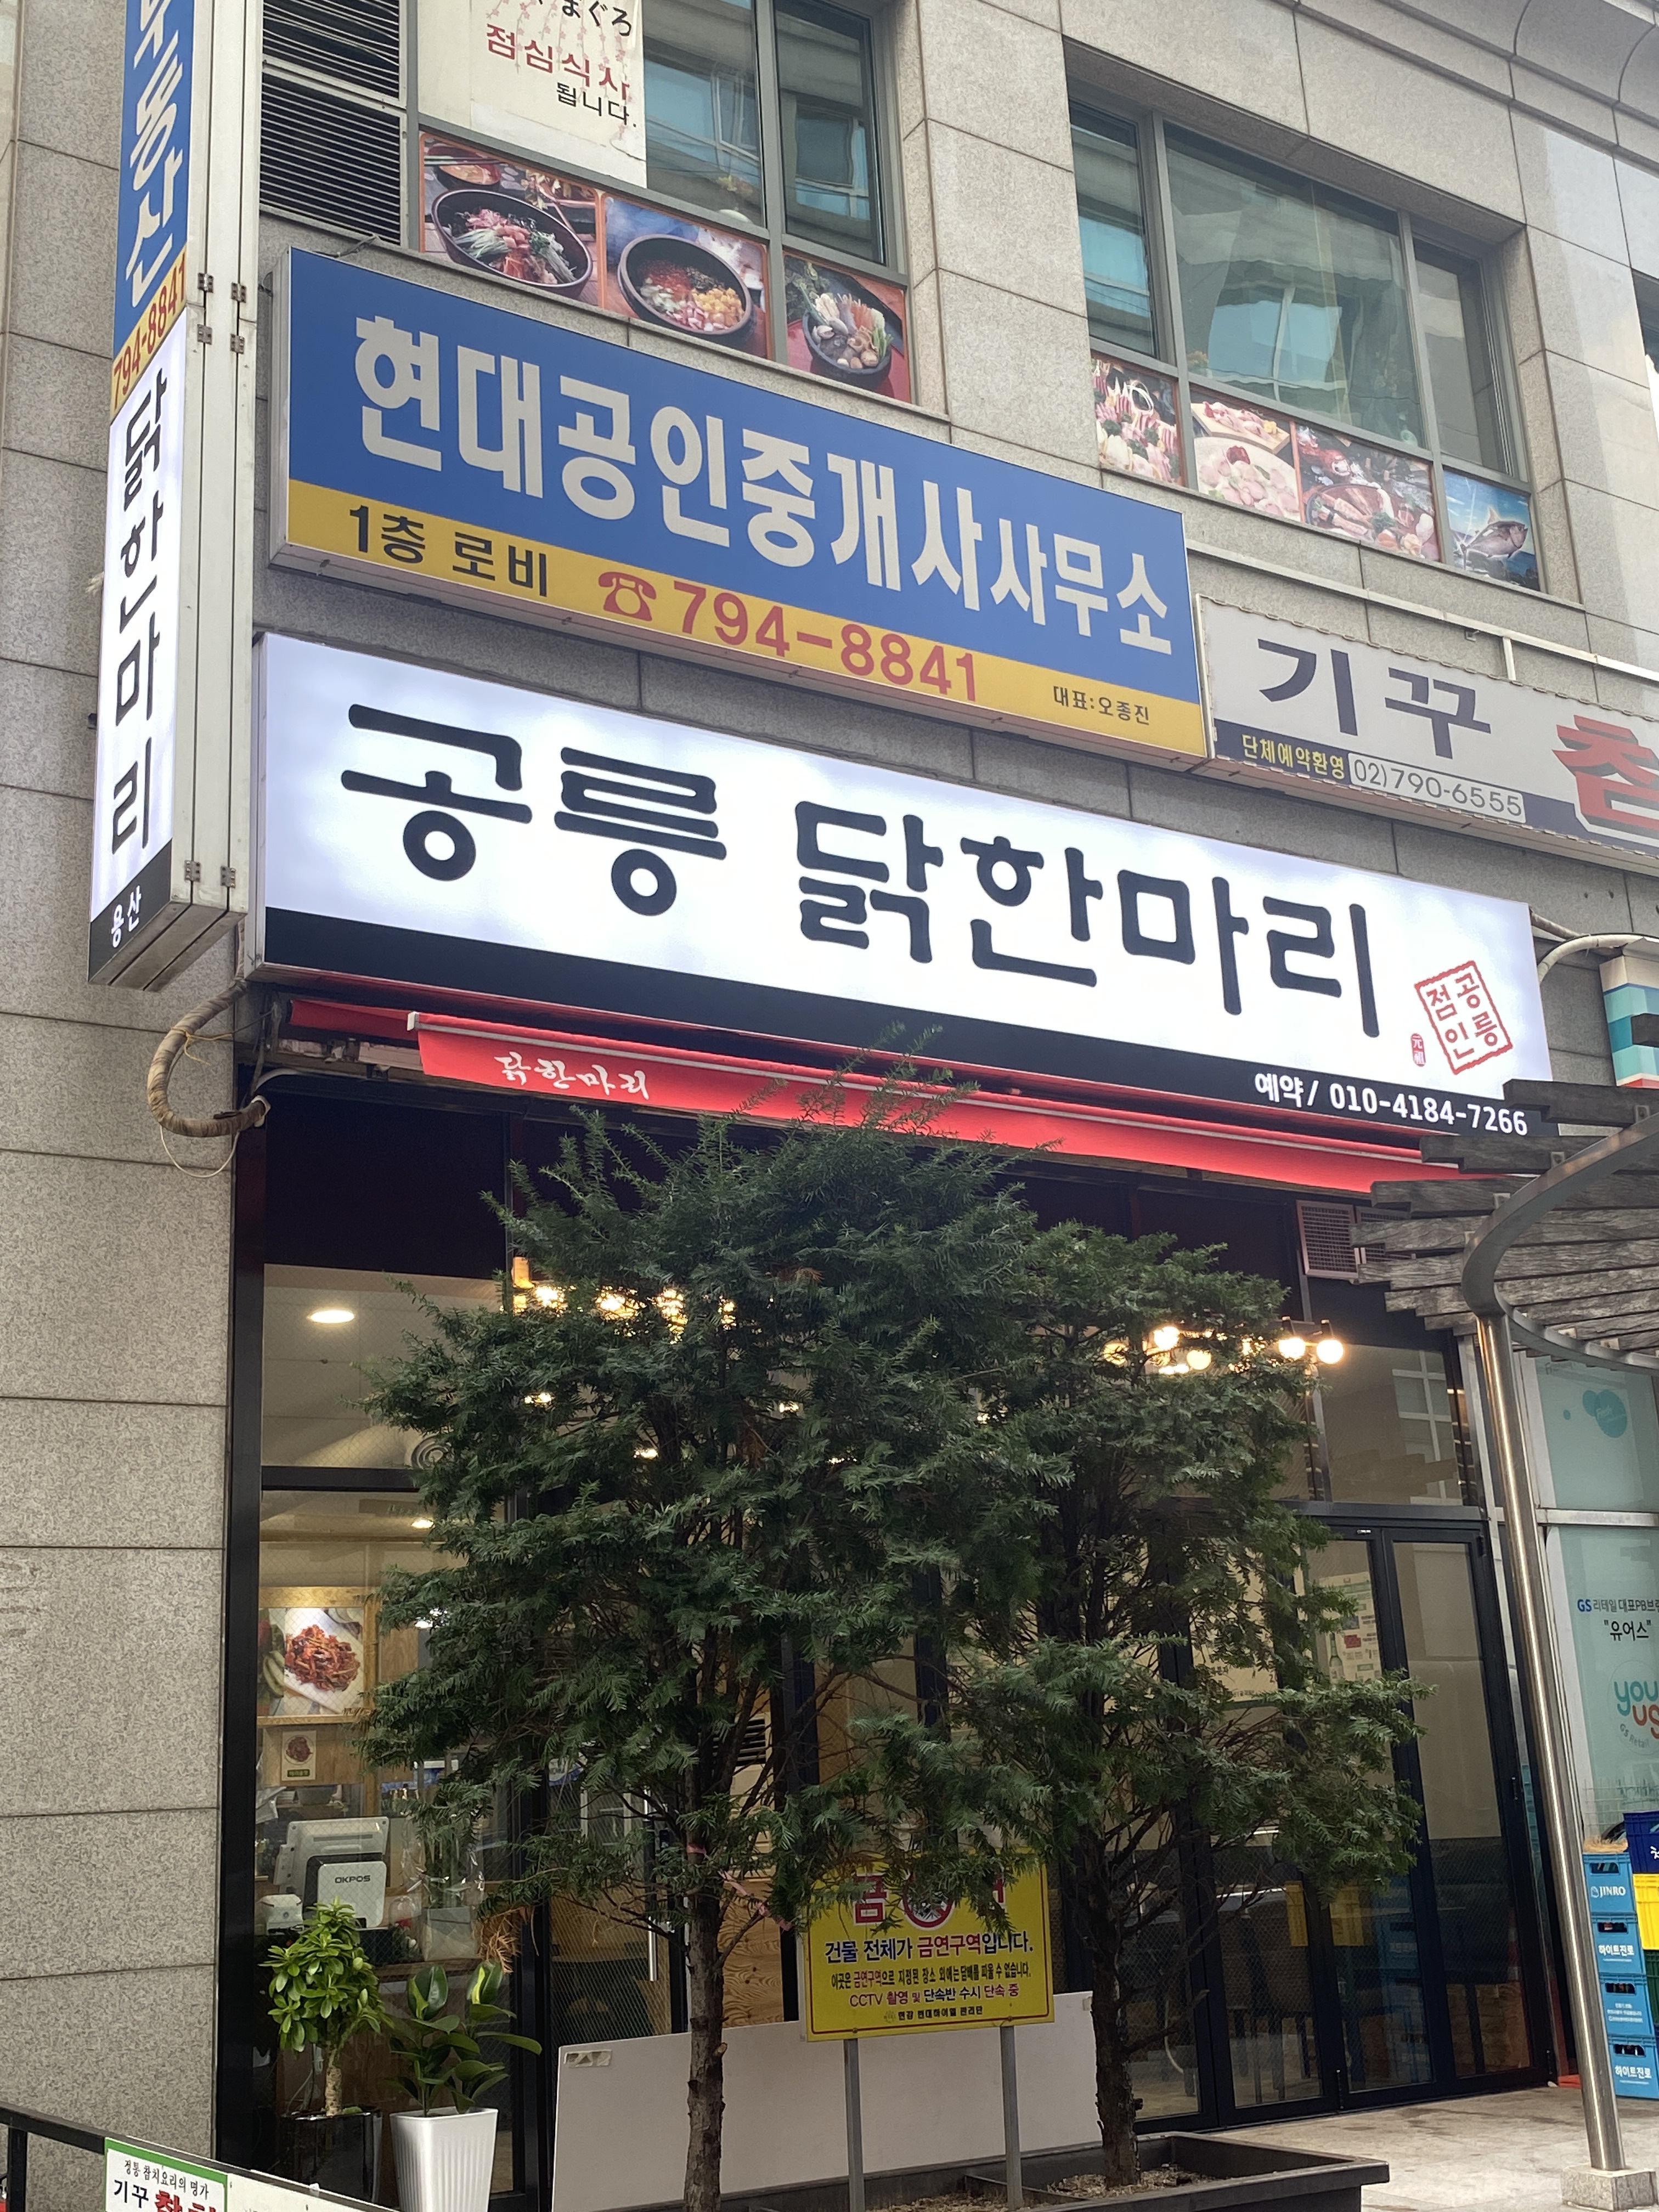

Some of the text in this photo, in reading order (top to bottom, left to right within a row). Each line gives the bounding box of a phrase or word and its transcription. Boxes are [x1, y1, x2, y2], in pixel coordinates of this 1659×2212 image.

[486, 23, 630, 100] 점심식사
[556, 82, 637, 128] 됩니다.
[113, 253, 186, 410] 794-8841
[111, 367, 167, 855] 닭한마리
[349, 505, 1150, 726] 1층 로비 794-8841 대표:오종진
[1257, 638, 1492, 760] 기꾸
[1242, 733, 1522, 816] 단체예약환영 02)790-6555
[341, 704, 1380, 1039] 공릉 닭한마리
[111, 885, 142, 948] 용산
[494, 1051, 649, 1100] 닭한마리
[1330, 1083, 1528, 1136] 010-4184-7266
[335, 1875, 371, 1883] OKPOS
[1599, 1886, 1626, 1898] JINRO
[825, 1940, 857, 1964] 건물
[864, 1937, 913, 1961] 전체가
[1598, 1945, 1635, 1957] 하이트진로
[850, 1993, 883, 2007] CCTV
[887, 1991, 909, 2005] 촬영
[923, 1987, 956, 2002] 단속반
[959, 1985, 981, 2000] 수시
[984, 1984, 1006, 1999] 단속
[1008, 1983, 1019, 1997] 중
[1615, 2064, 1652, 2079] 하이트진로
[114, 2179, 149, 2209] 기꾸
[124, 2159, 210, 2200] 정통 참치요리의 명가
